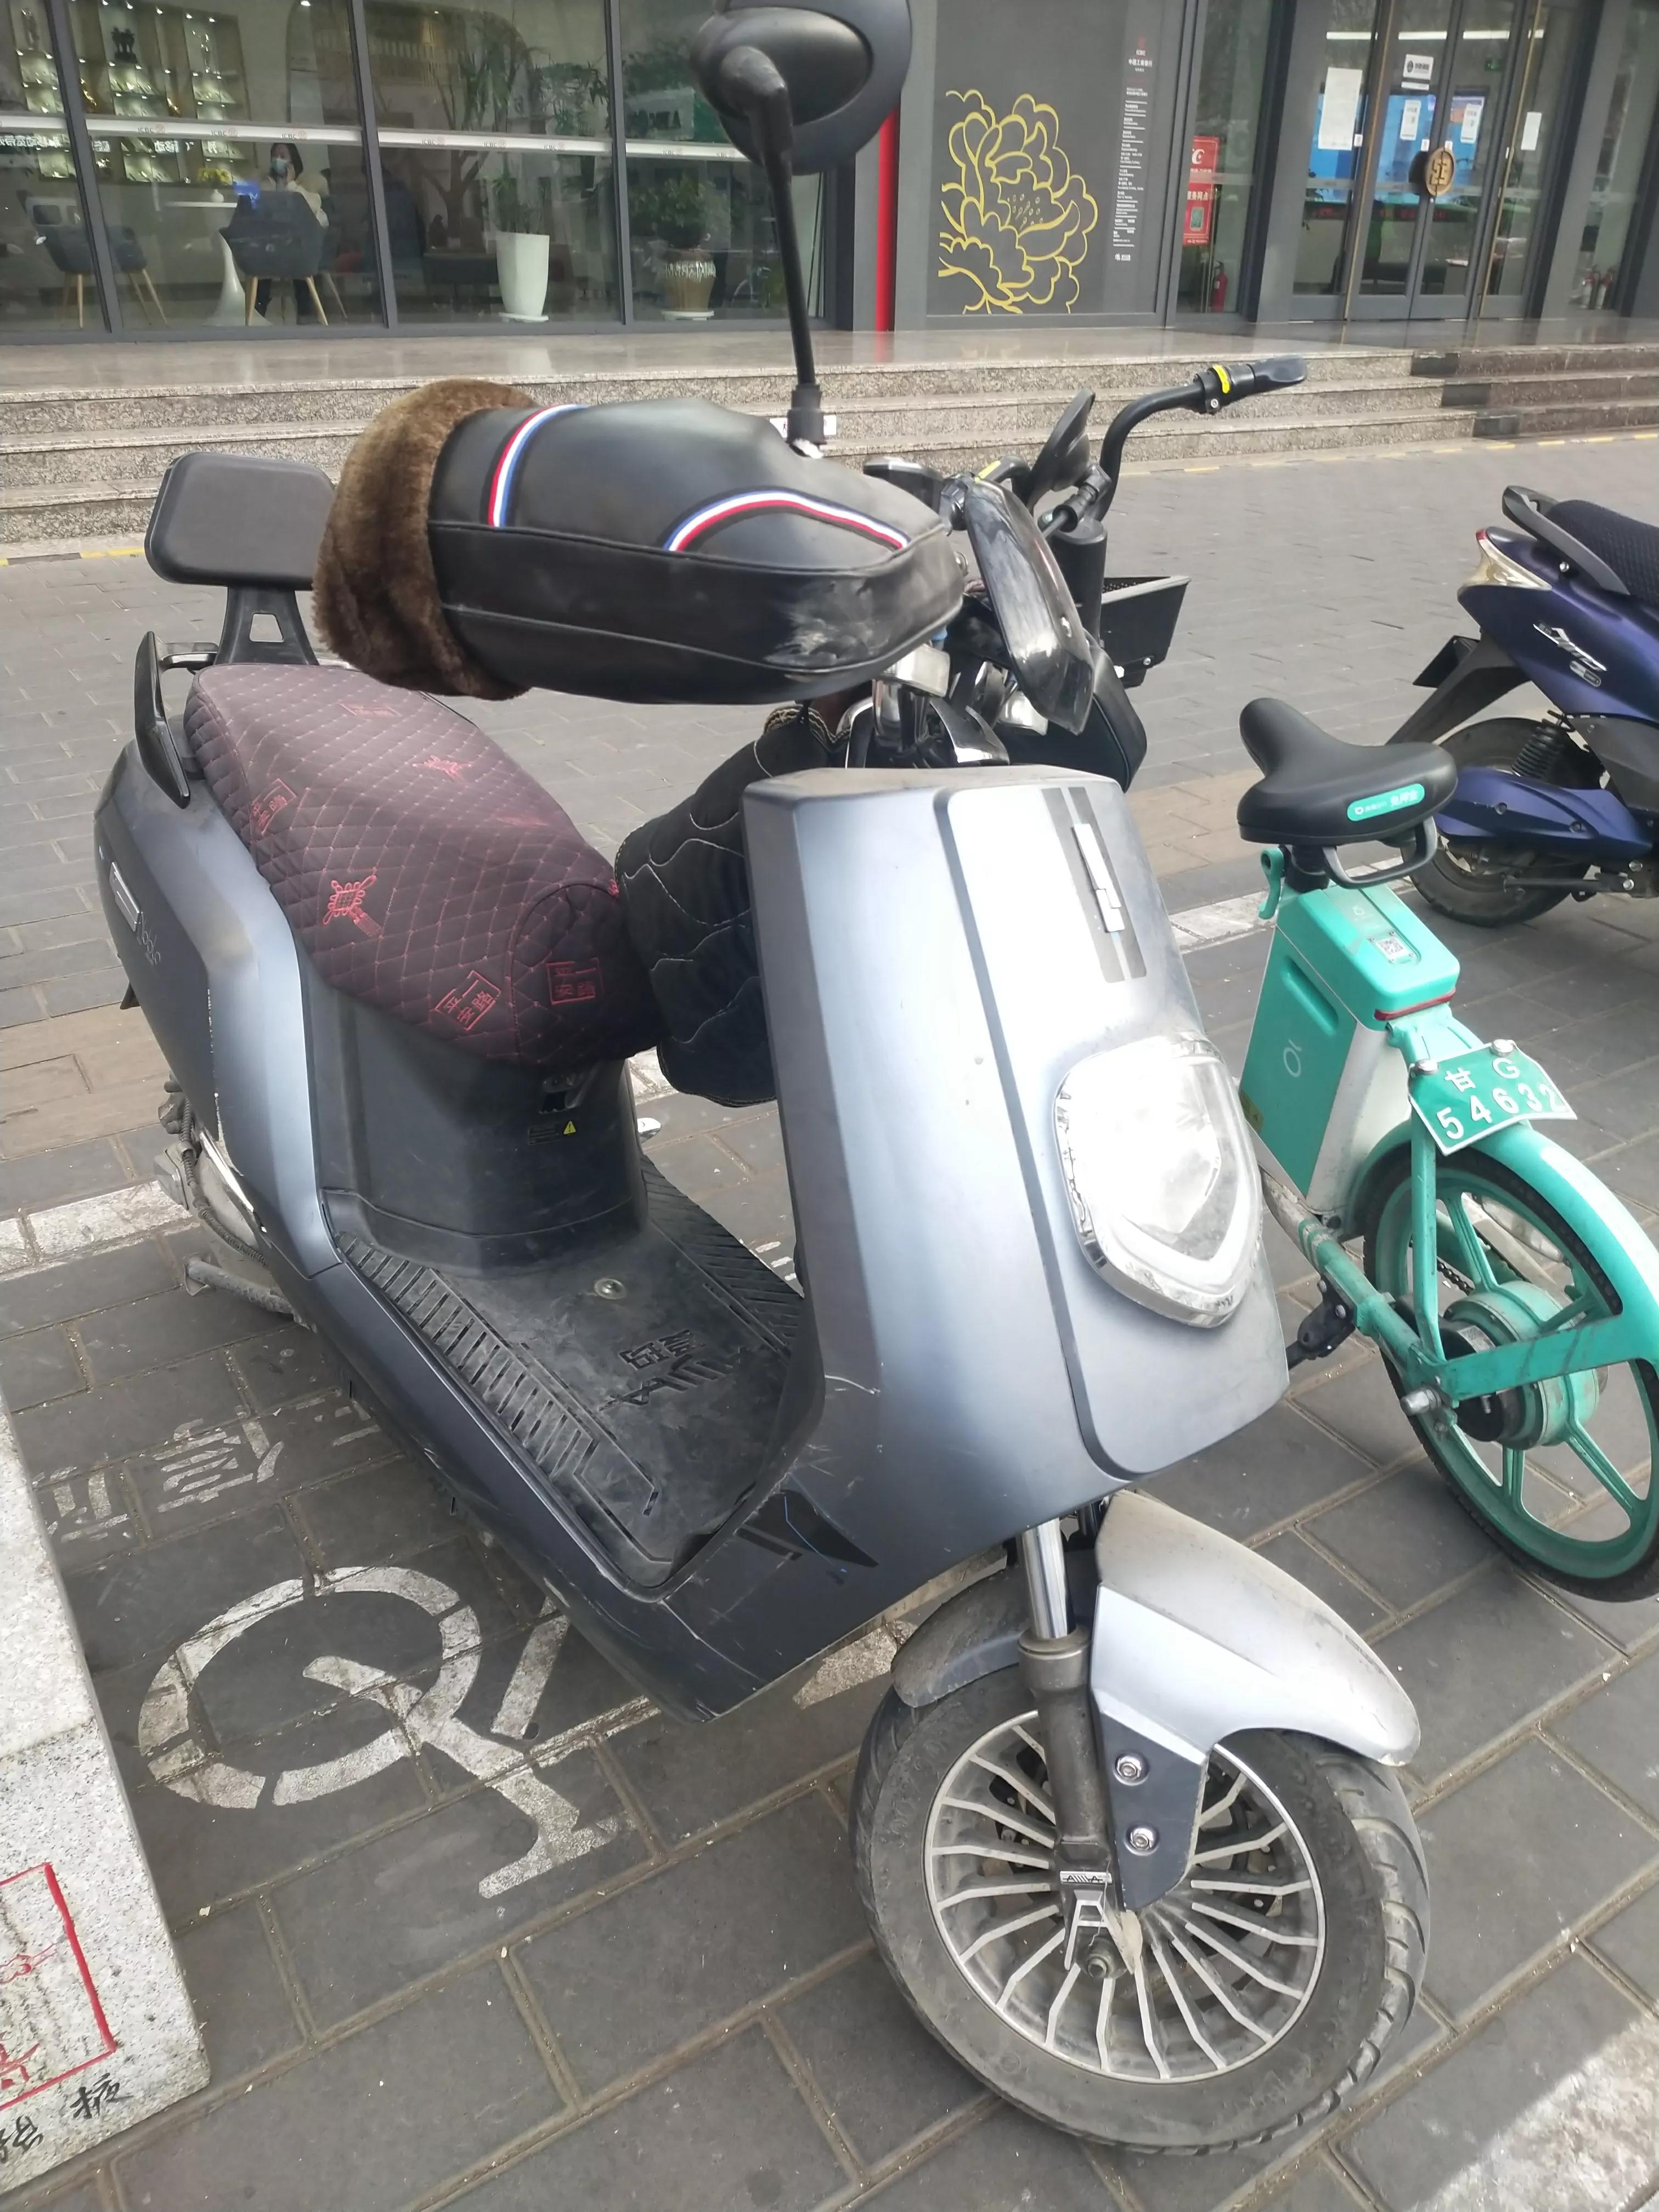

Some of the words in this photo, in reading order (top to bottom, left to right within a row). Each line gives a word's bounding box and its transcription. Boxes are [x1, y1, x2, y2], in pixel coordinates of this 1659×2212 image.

[1444, 1067, 1476, 1092] 甘
[1492, 1057, 1520, 1079] G
[1436, 1082, 1568, 1139] 54632
